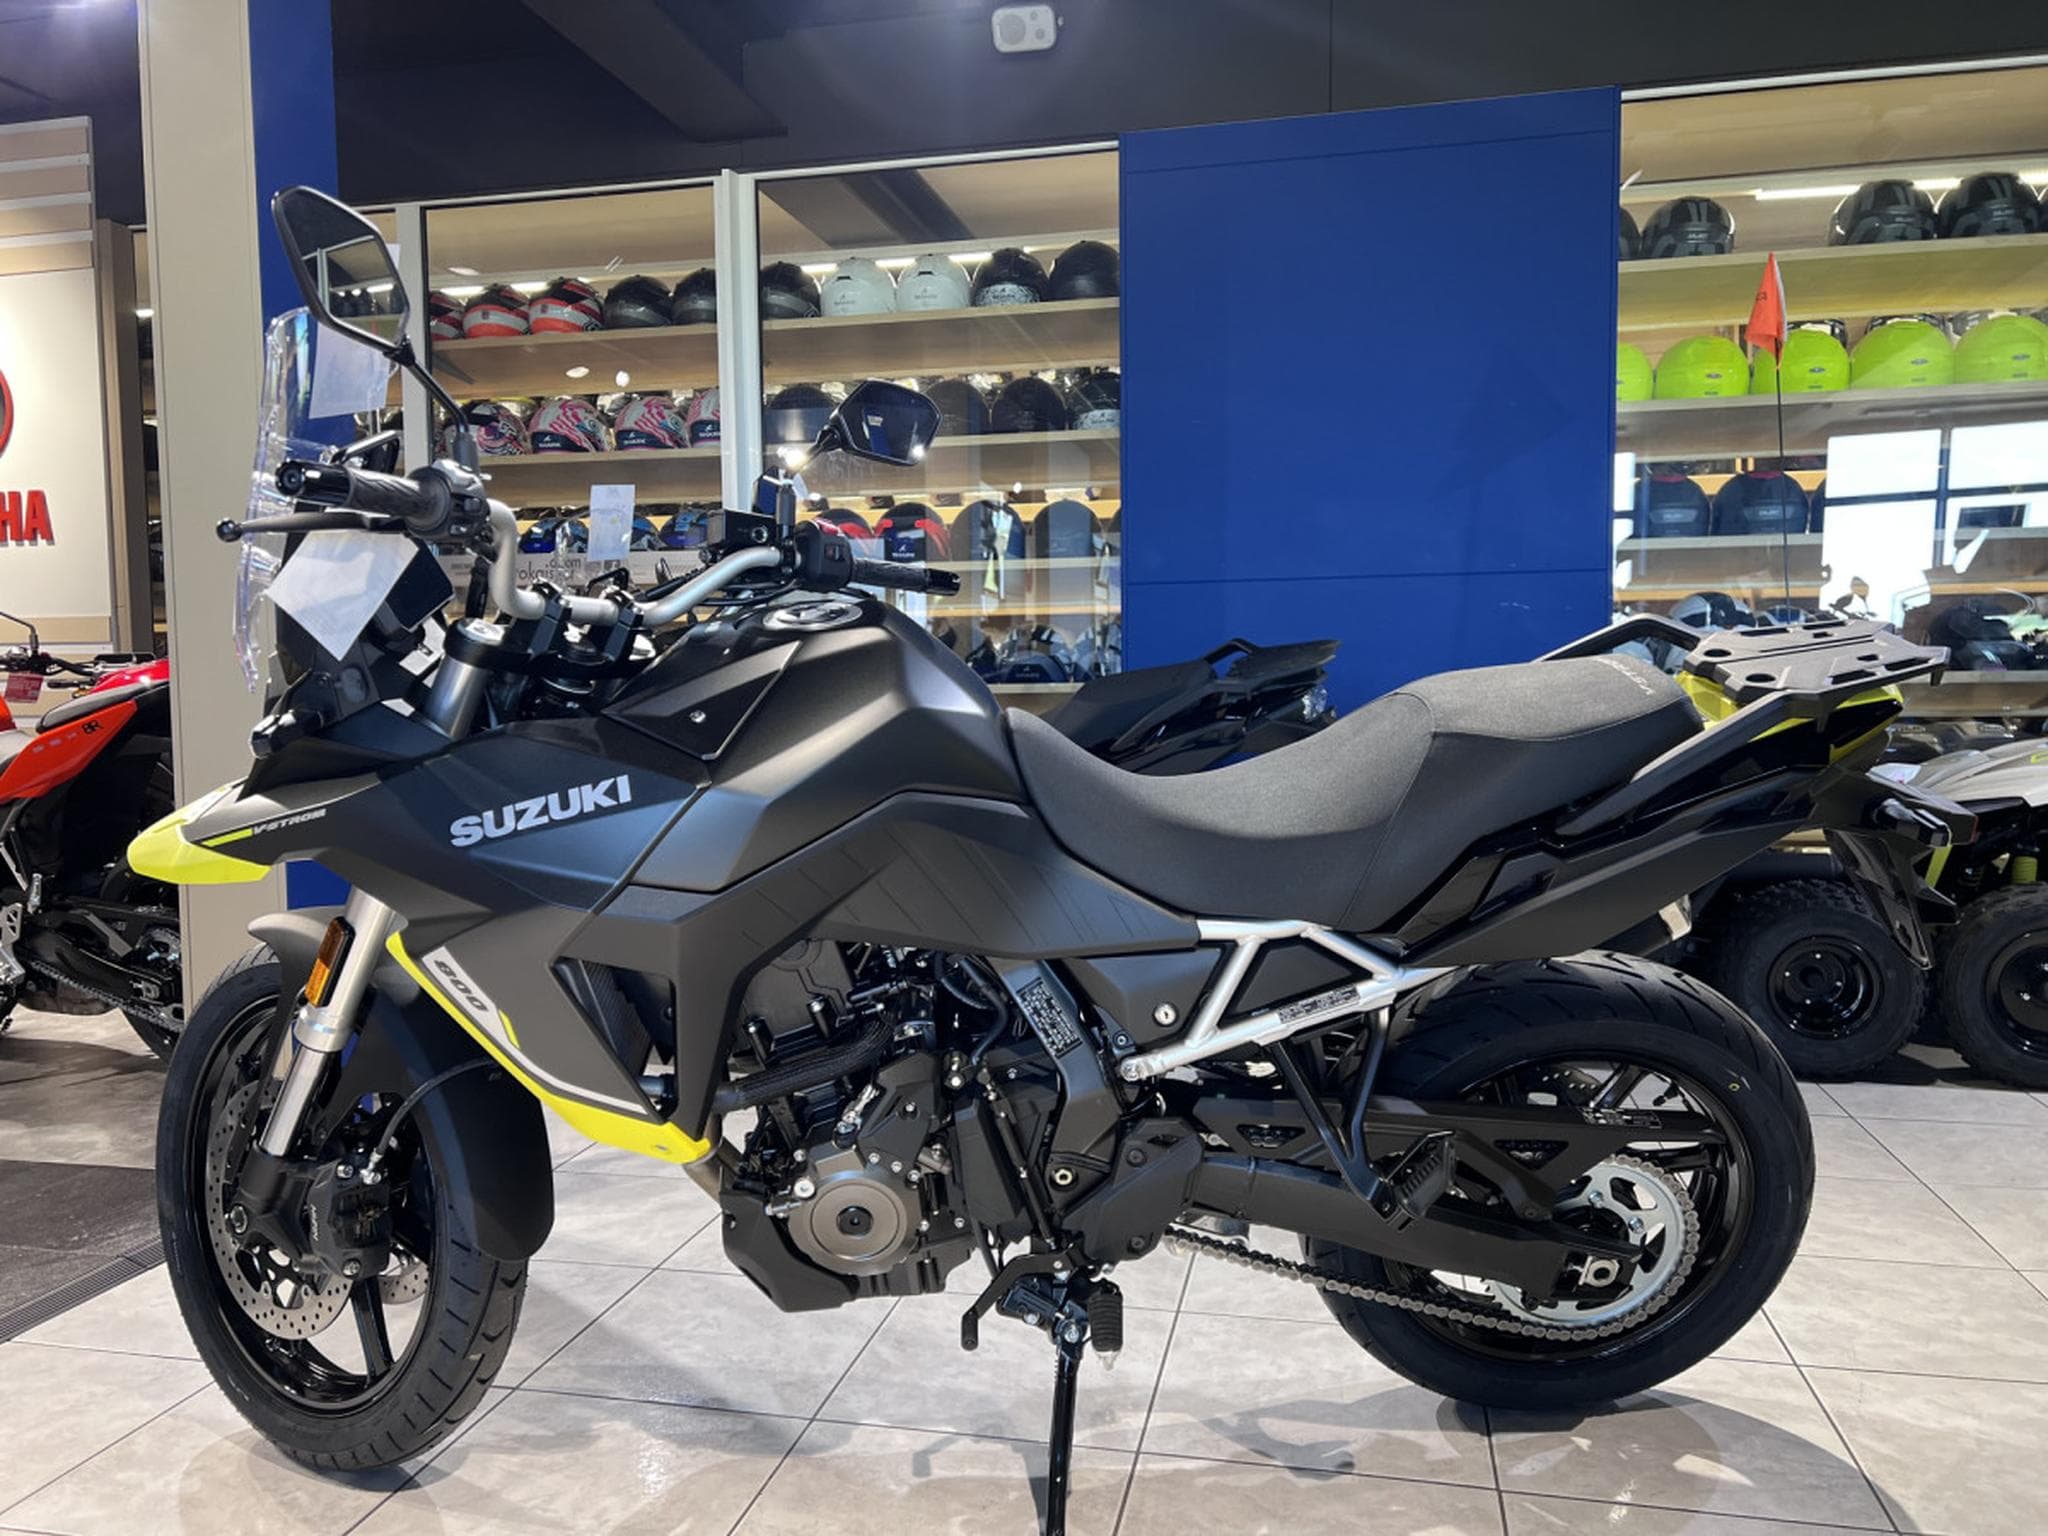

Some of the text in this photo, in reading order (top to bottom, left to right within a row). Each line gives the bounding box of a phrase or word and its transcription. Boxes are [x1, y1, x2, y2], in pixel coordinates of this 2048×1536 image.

[254, 808, 327, 835] V-STROM
[450, 774, 632, 848] SUZUKI
[433, 960, 489, 1012] 800
